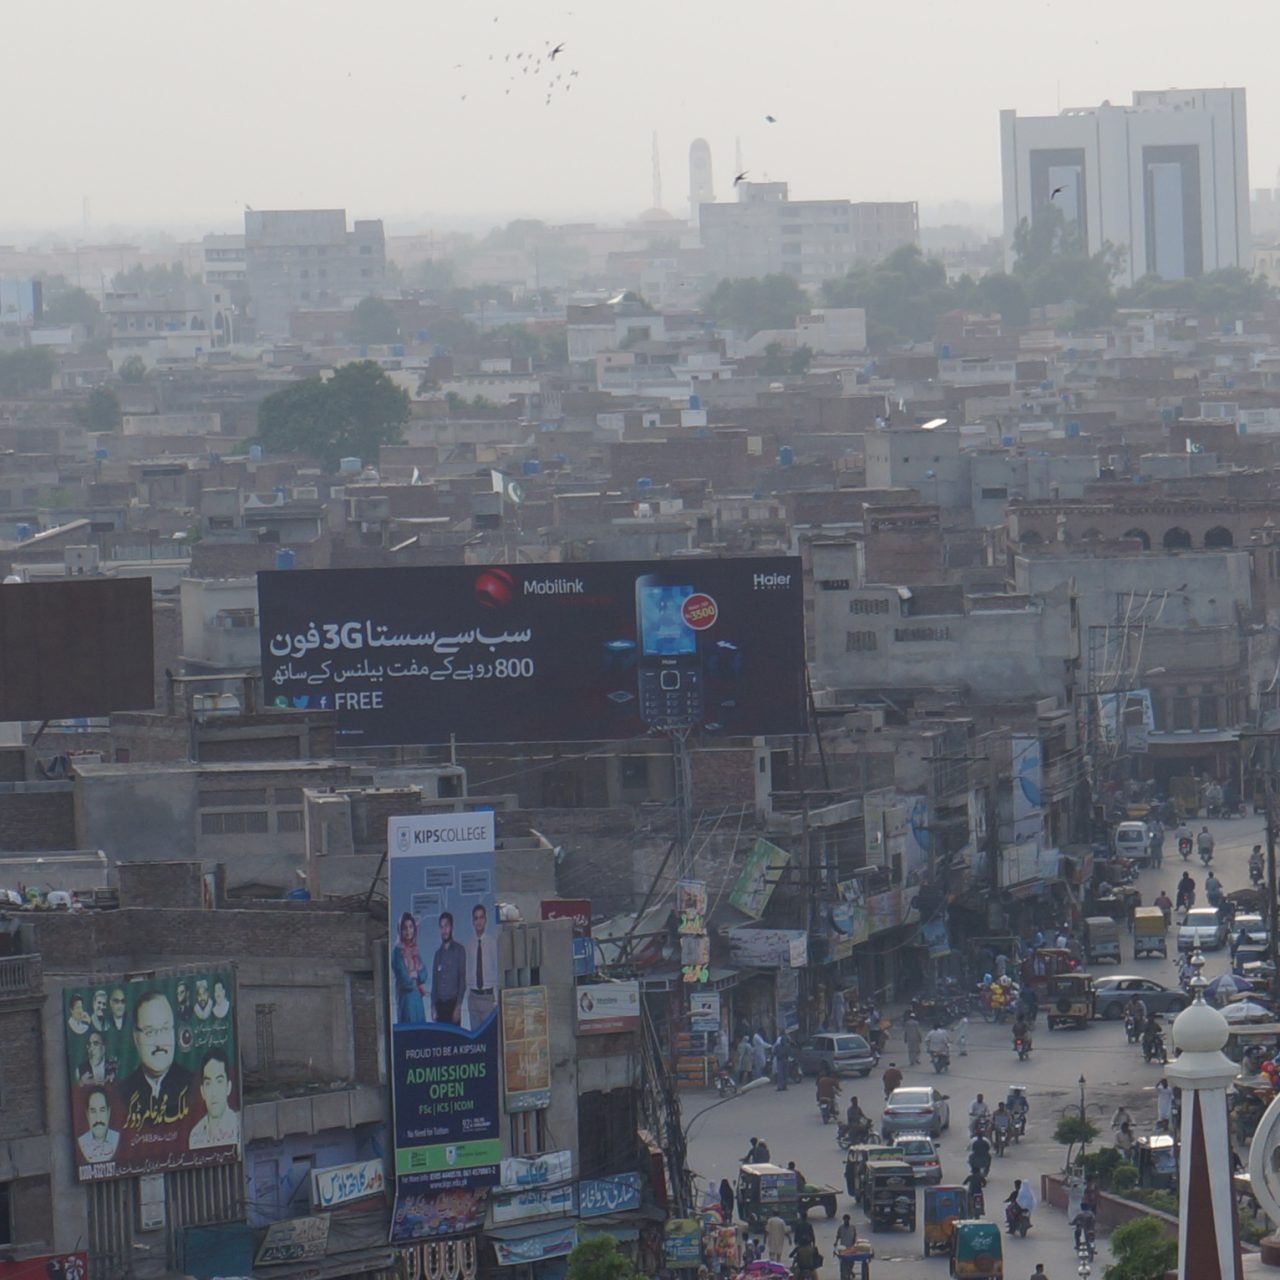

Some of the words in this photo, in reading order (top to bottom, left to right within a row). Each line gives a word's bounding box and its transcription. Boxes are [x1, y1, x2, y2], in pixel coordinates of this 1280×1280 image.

[524, 578, 585, 596] Mobilink
[753, 572, 792, 587] Haier
[269, 622, 322, 658] فون
[323, 621, 364, 650] 3G
[494, 658, 534, 679] 800
[335, 691, 384, 711] FREE
[405, 1047, 431, 1060] PROUD
[432, 1047, 442, 1058] TO
[443, 1045, 452, 1057] BE
[453, 1045, 459, 1056] A
[406, 1062, 487, 1085] ADMISSIONS
[429, 1081, 465, 1100] OPEN
